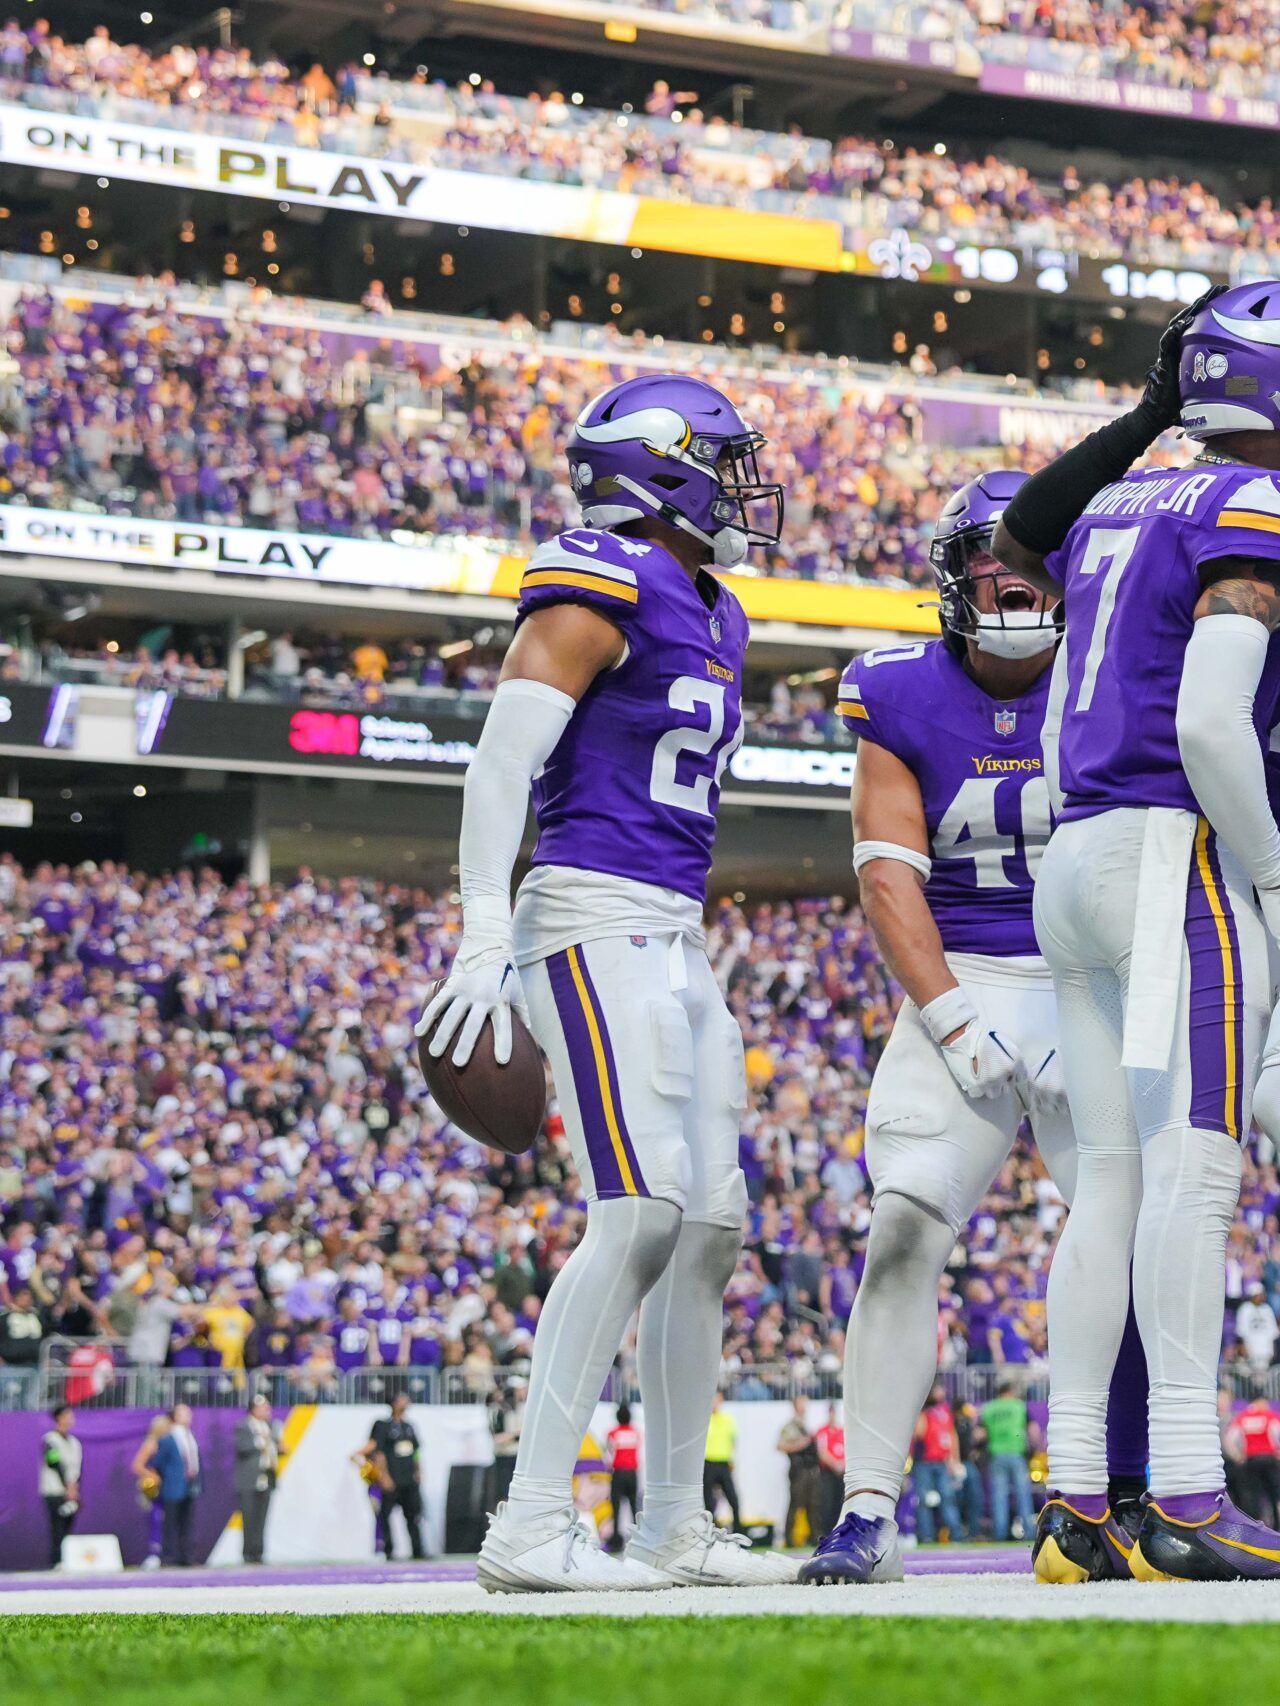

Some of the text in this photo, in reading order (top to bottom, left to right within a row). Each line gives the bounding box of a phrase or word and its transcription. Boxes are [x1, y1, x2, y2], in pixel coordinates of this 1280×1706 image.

[27, 126, 424, 207] ON THE PLAY
[1157, 473, 1217, 516] JR
[26, 519, 75, 540] ON
[172, 532, 333, 571] PLAY
[1075, 526, 1142, 712] 7
